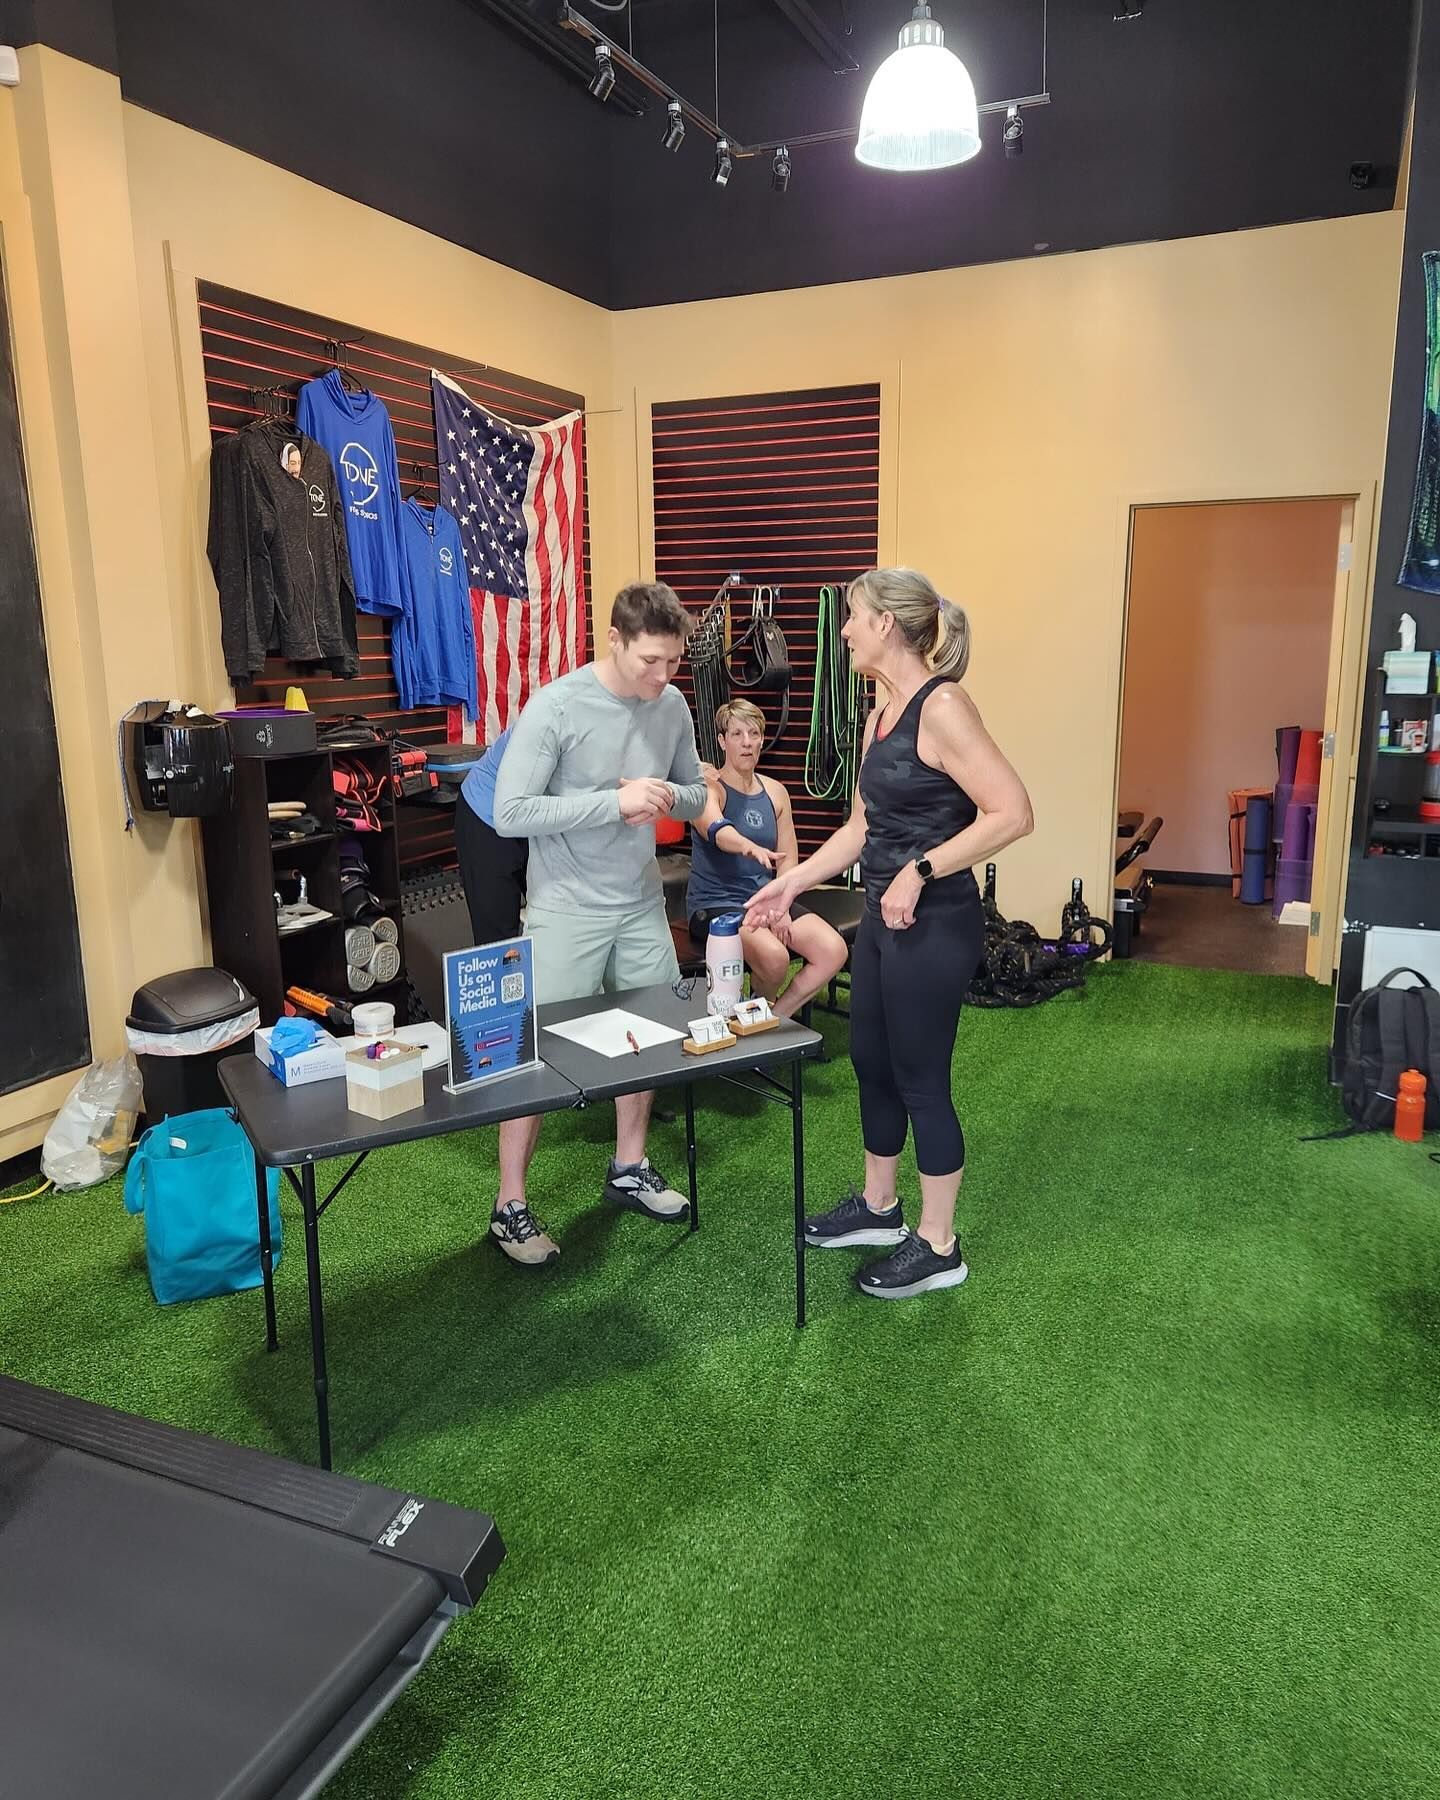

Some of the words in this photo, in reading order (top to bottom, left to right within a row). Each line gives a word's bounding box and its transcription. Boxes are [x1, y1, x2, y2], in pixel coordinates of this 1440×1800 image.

[457, 957, 498, 975] Follow
[458, 974, 473, 987] Us
[475, 973, 491, 984] on
[459, 980, 495, 1001] Social
[459, 996, 497, 1014] Media
[291, 1066, 301, 1077] M
[386, 1502, 425, 1547] FLEX
